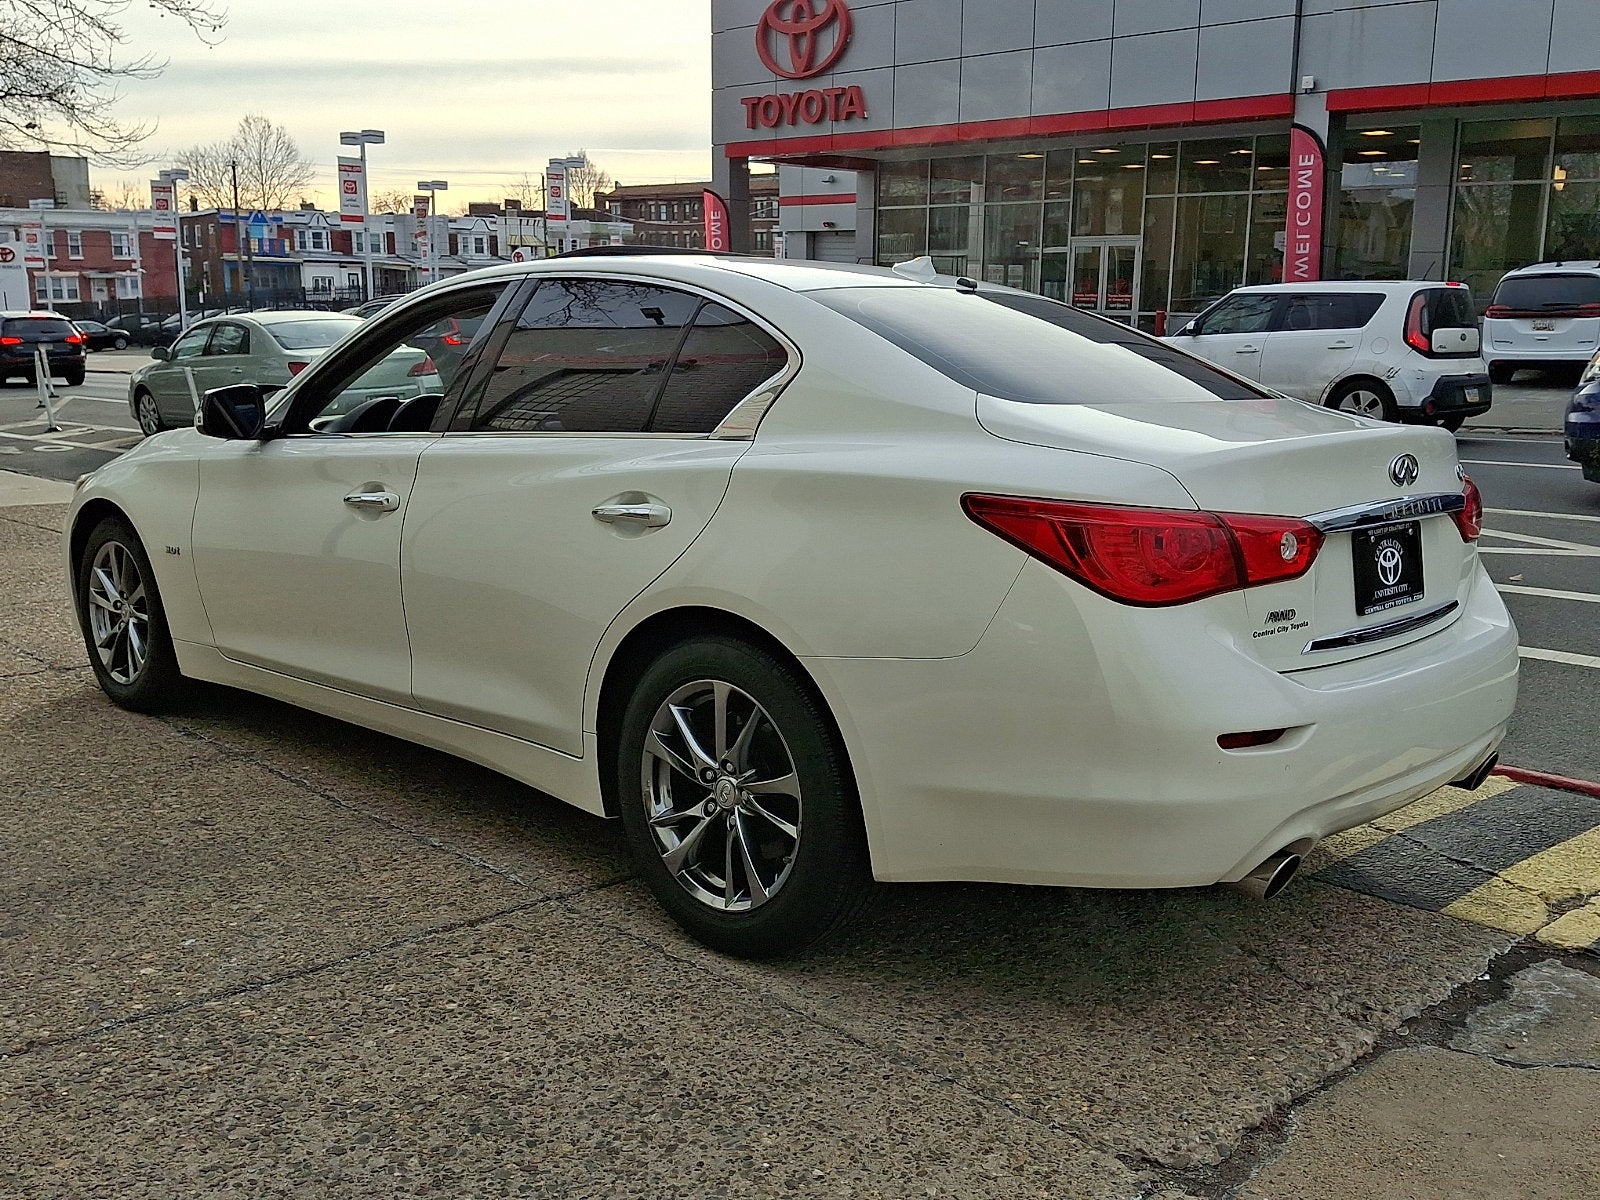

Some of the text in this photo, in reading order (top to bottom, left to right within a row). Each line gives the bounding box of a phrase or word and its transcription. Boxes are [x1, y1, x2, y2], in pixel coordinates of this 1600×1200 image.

[741, 85, 868, 130] TOYOTA
[1264, 608, 1296, 624] AWD
[1252, 620, 1309, 638] Central City Toyota
